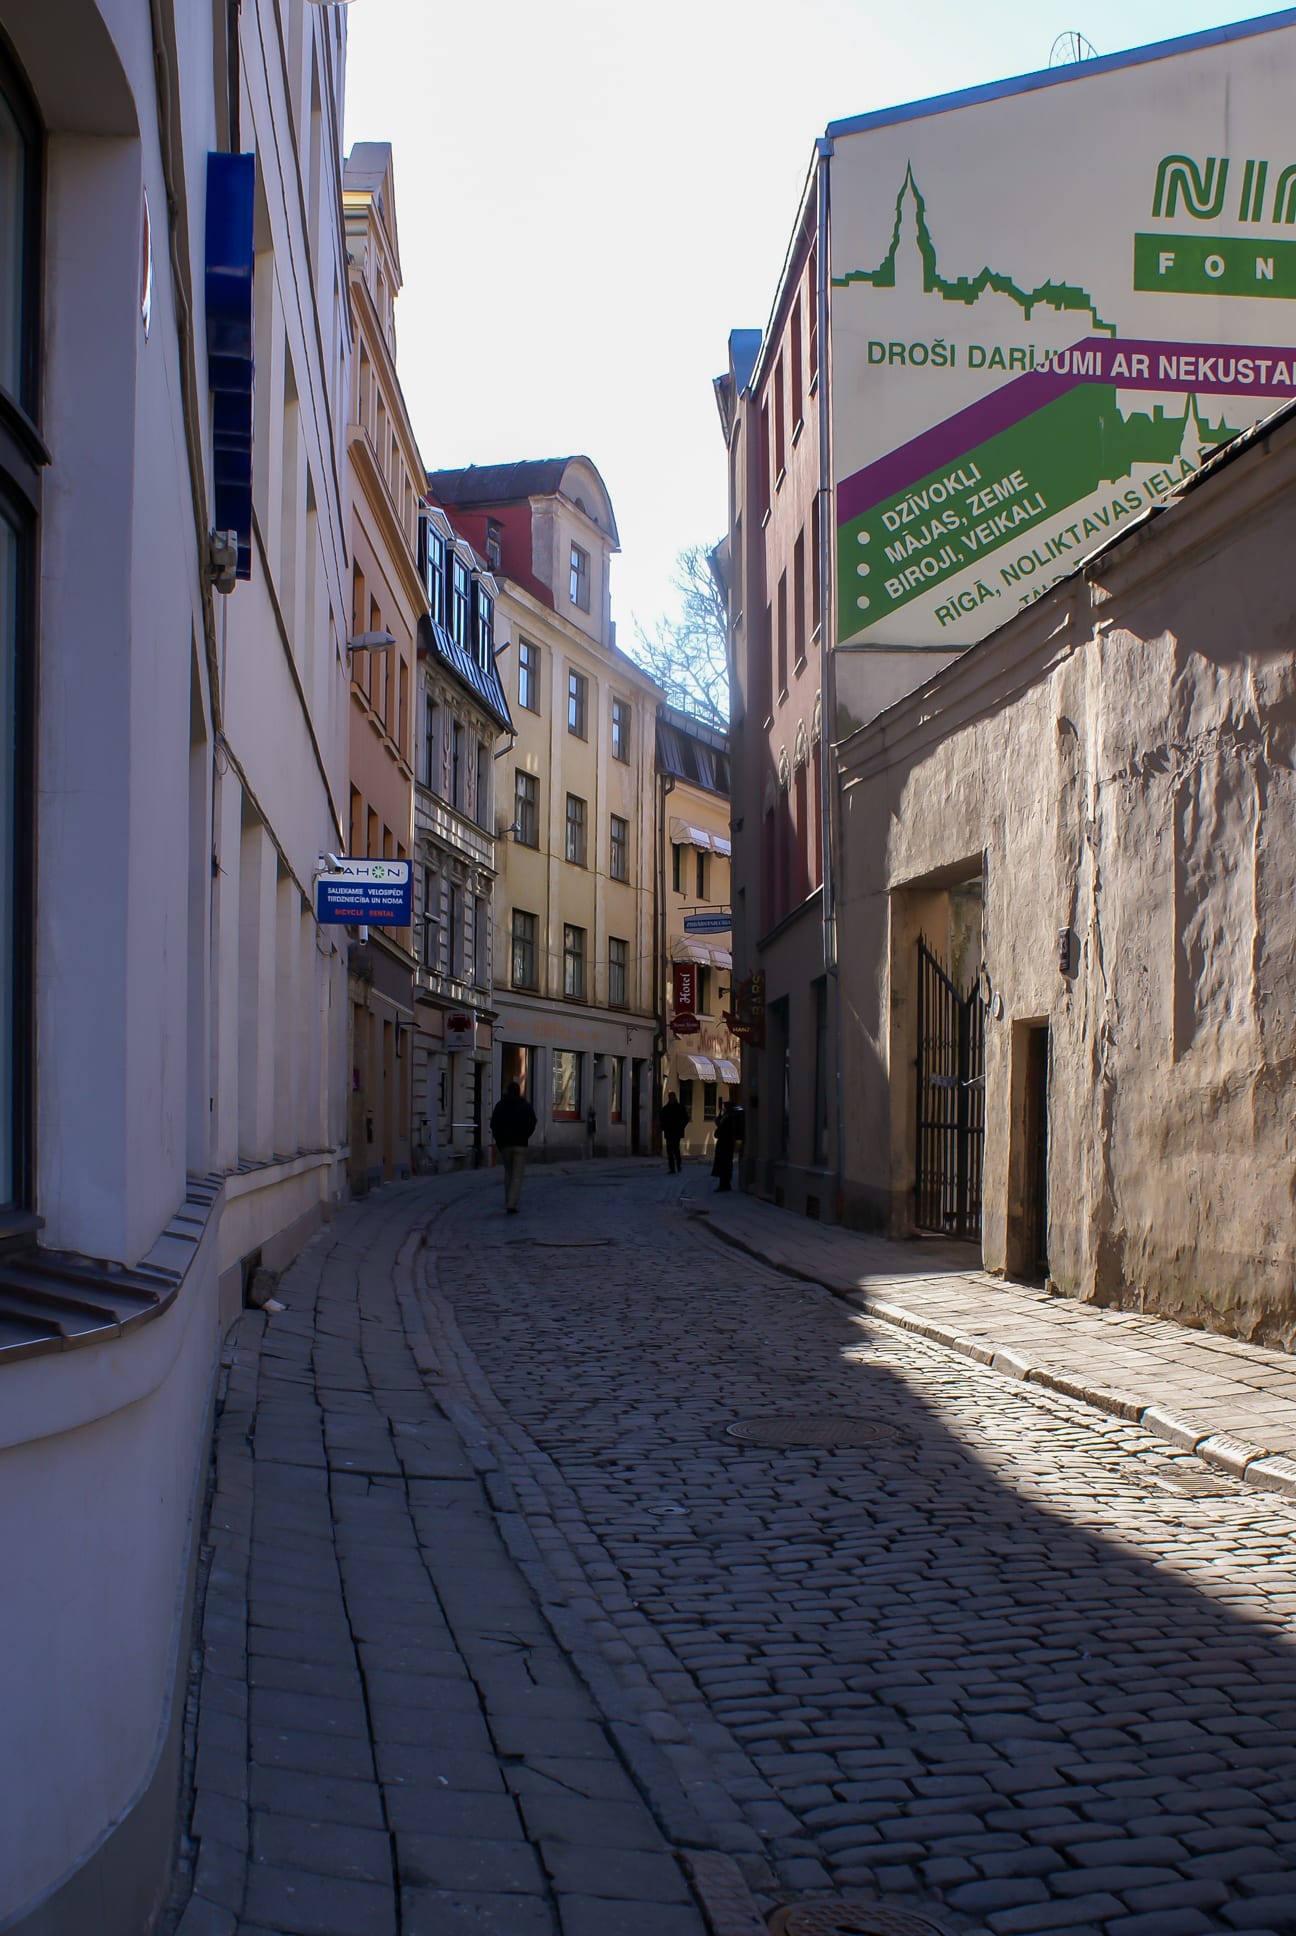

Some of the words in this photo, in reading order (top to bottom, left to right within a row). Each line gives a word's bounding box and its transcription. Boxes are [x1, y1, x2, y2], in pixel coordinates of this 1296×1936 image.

[867, 338, 956, 368] DROŠI
[967, 344, 1102, 376] DARĪJUMI
[1110, 352, 1150, 379] AR
[1158, 355, 1296, 386] NEKUSTA
[881, 462, 982, 532] DZĪVOKĻI
[884, 510, 968, 565] MĀJAS,
[966, 470, 1029, 517] ZEME
[883, 545, 965, 599] BIROJI,
[960, 492, 1048, 551] VEIKALI
[934, 579, 1001, 627] RĪGĀ,
[1000, 490, 1142, 587] NOLIKTAVAS
[1142, 455, 1197, 499] IELĀ
[335, 908, 364, 917] BICYCLE
[369, 909, 395, 918] RENTAL
[382, 897, 403, 905] NOMA
[680, 973, 691, 1004] Hotel
